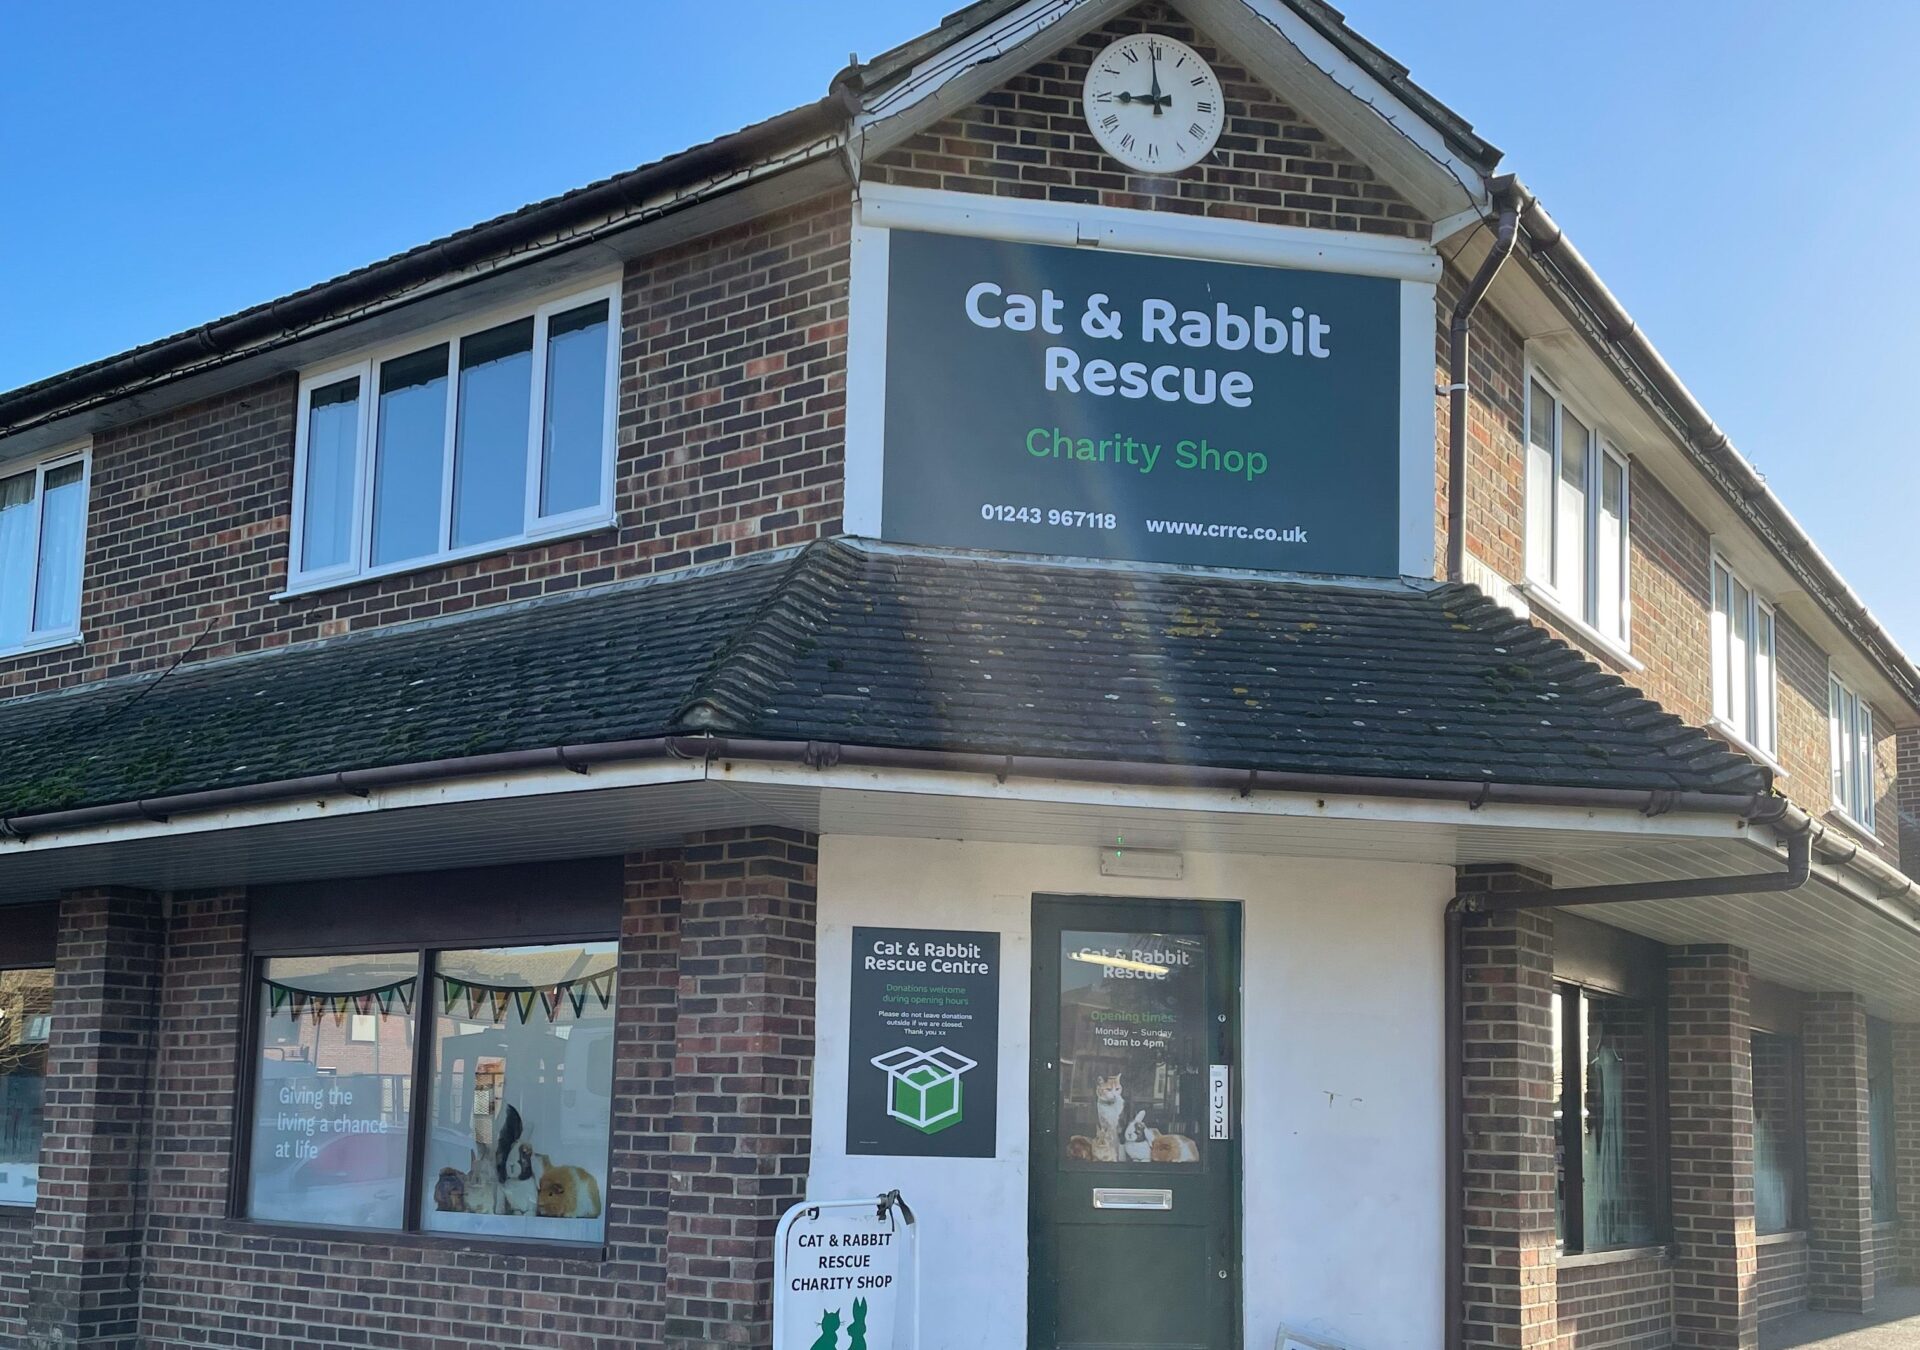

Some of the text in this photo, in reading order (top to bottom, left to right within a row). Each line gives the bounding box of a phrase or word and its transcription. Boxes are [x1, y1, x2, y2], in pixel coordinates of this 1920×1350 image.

[965, 282, 1331, 358] Cat & Rabbit
[1045, 347, 1254, 408] Rescue
[1026, 427, 1268, 481] Charity Shop
[981, 503, 1117, 530] 01243 967118
[1146, 518, 1308, 543] www.crrc.co.uk
[873, 941, 981, 958] Cat & Rabbit
[1131, 949, 1189, 965] Rabbit
[865, 956, 989, 974] Rescue Centre
[886, 984, 966, 994] Donations welcome
[882, 994, 969, 1006] during opening hours
[878, 1010, 899, 1018] Please
[1091, 1010, 1176, 1024] Opening times:
[1095, 1027, 1129, 1037] Monday
[1140, 1029, 1173, 1038] Sunday
[1103, 1038, 1164, 1048] 10am to 4pm
[280, 1086, 352, 1110] Giving the
[1214, 1080, 1223, 1138] PUSH
[277, 1112, 388, 1137] living a chance
[275, 1139, 319, 1159] at life
[798, 1233, 892, 1247] CAT & RABBIT
[818, 1255, 870, 1269] RESCUE
[791, 1275, 893, 1291] CHARITY SHOP
